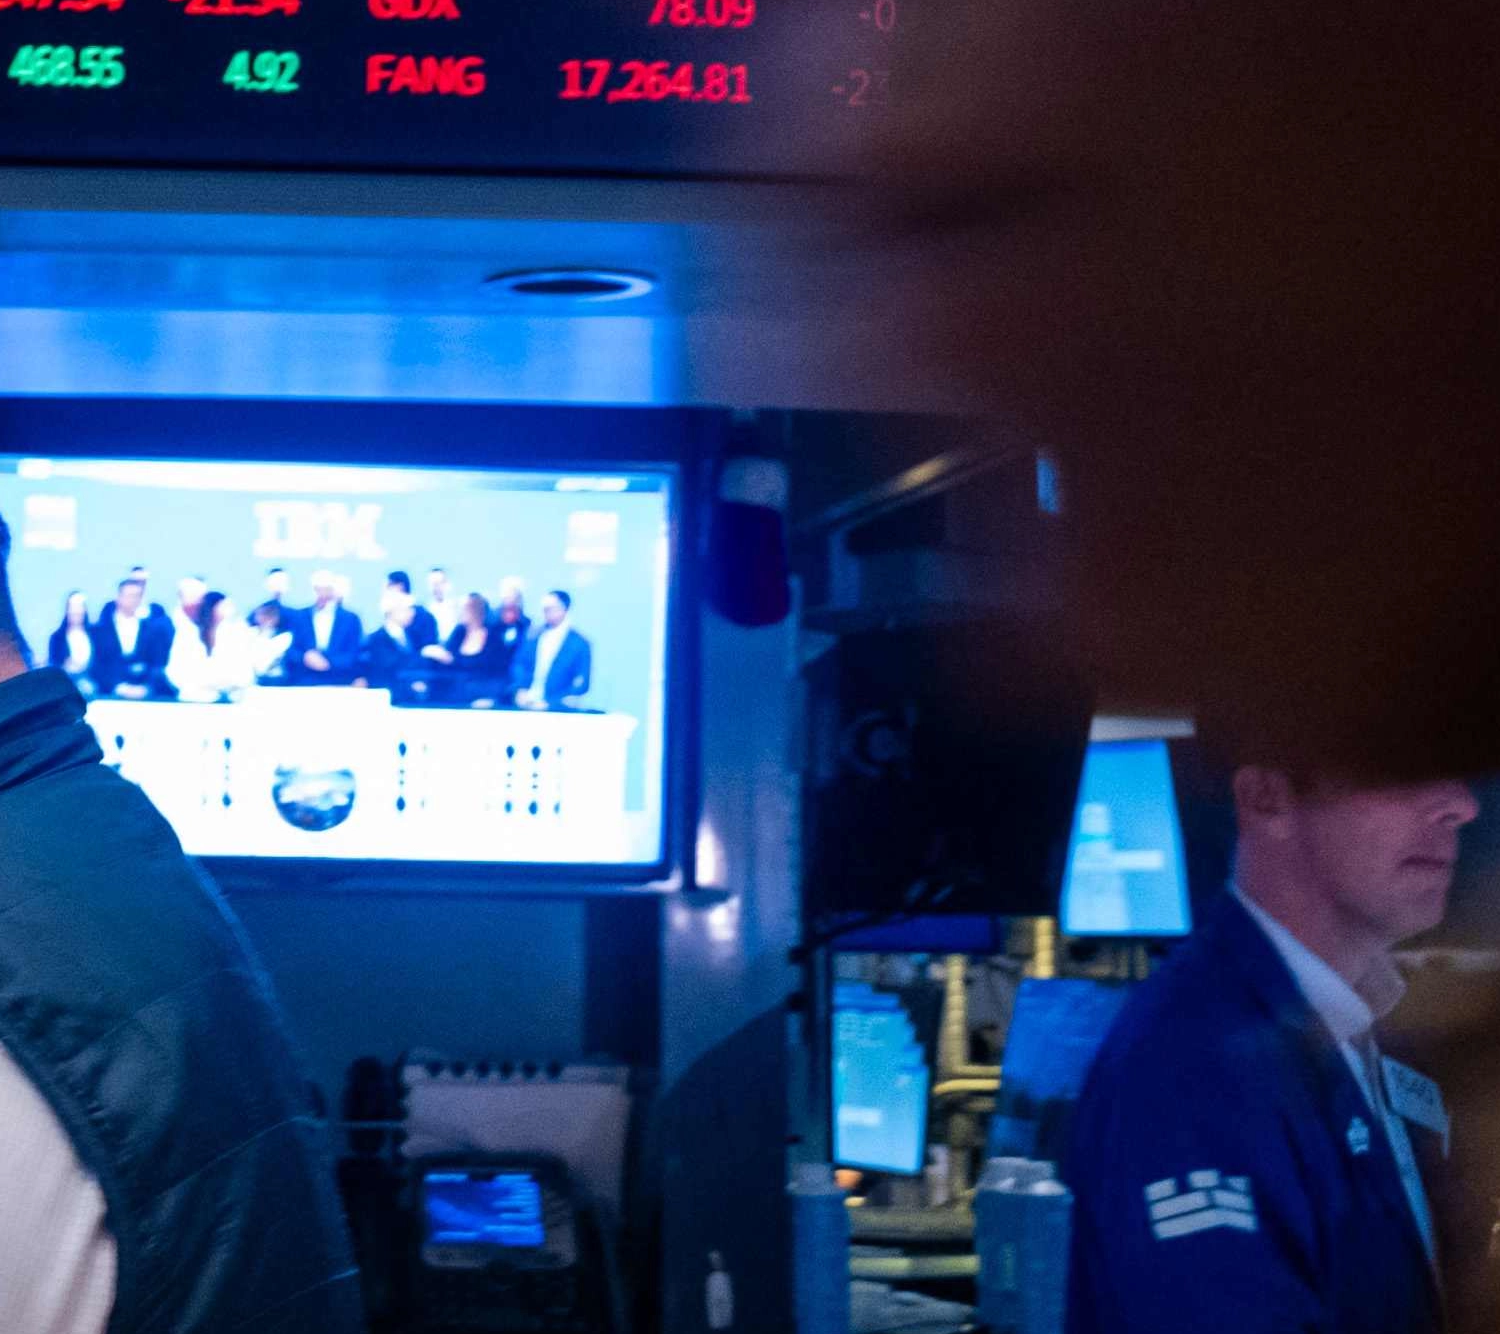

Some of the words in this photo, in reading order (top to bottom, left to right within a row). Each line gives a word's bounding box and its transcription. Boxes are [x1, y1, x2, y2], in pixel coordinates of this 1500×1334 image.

[222, 50, 301, 94] 4.92
[364, 54, 488, 97] FANG
[556, 59, 754, 104] 17,264.81
[252, 499, 390, 561] IBM
